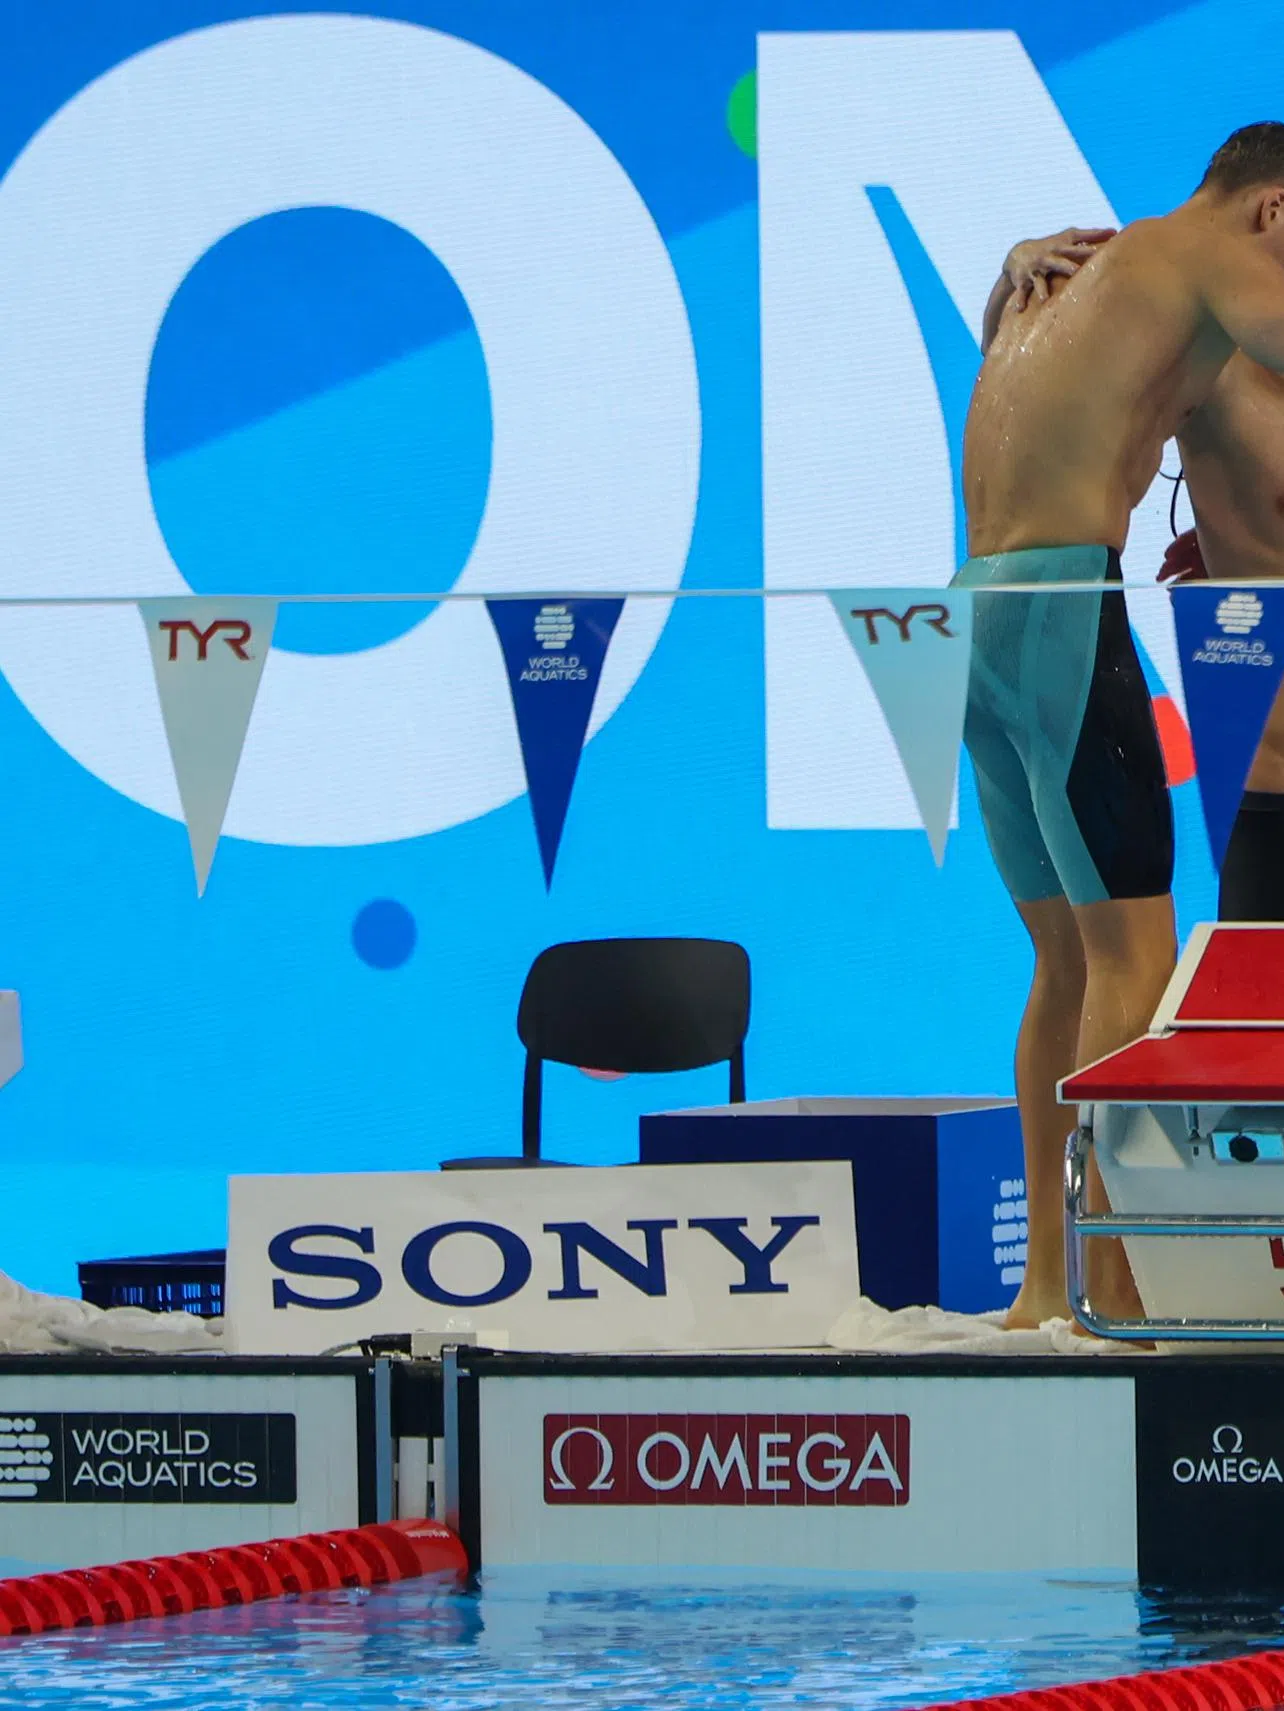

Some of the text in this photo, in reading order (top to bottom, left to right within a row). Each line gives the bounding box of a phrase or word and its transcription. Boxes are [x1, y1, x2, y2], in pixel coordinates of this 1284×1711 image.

[851, 604, 954, 645] TYR
[158, 619, 251, 661] TYR
[1205, 639, 1265, 654] WORLD
[528, 656, 580, 669] WORLD
[1192, 650, 1274, 667] AQUATICS
[520, 668, 588, 681] AQUATICS
[267, 1215, 821, 1310] SONY
[71, 1429, 210, 1456] WORLD
[72, 1461, 258, 1488] AQUATICS
[637, 1431, 904, 1491] OMEGA
[1172, 1457, 1284, 1483] OMEGA
